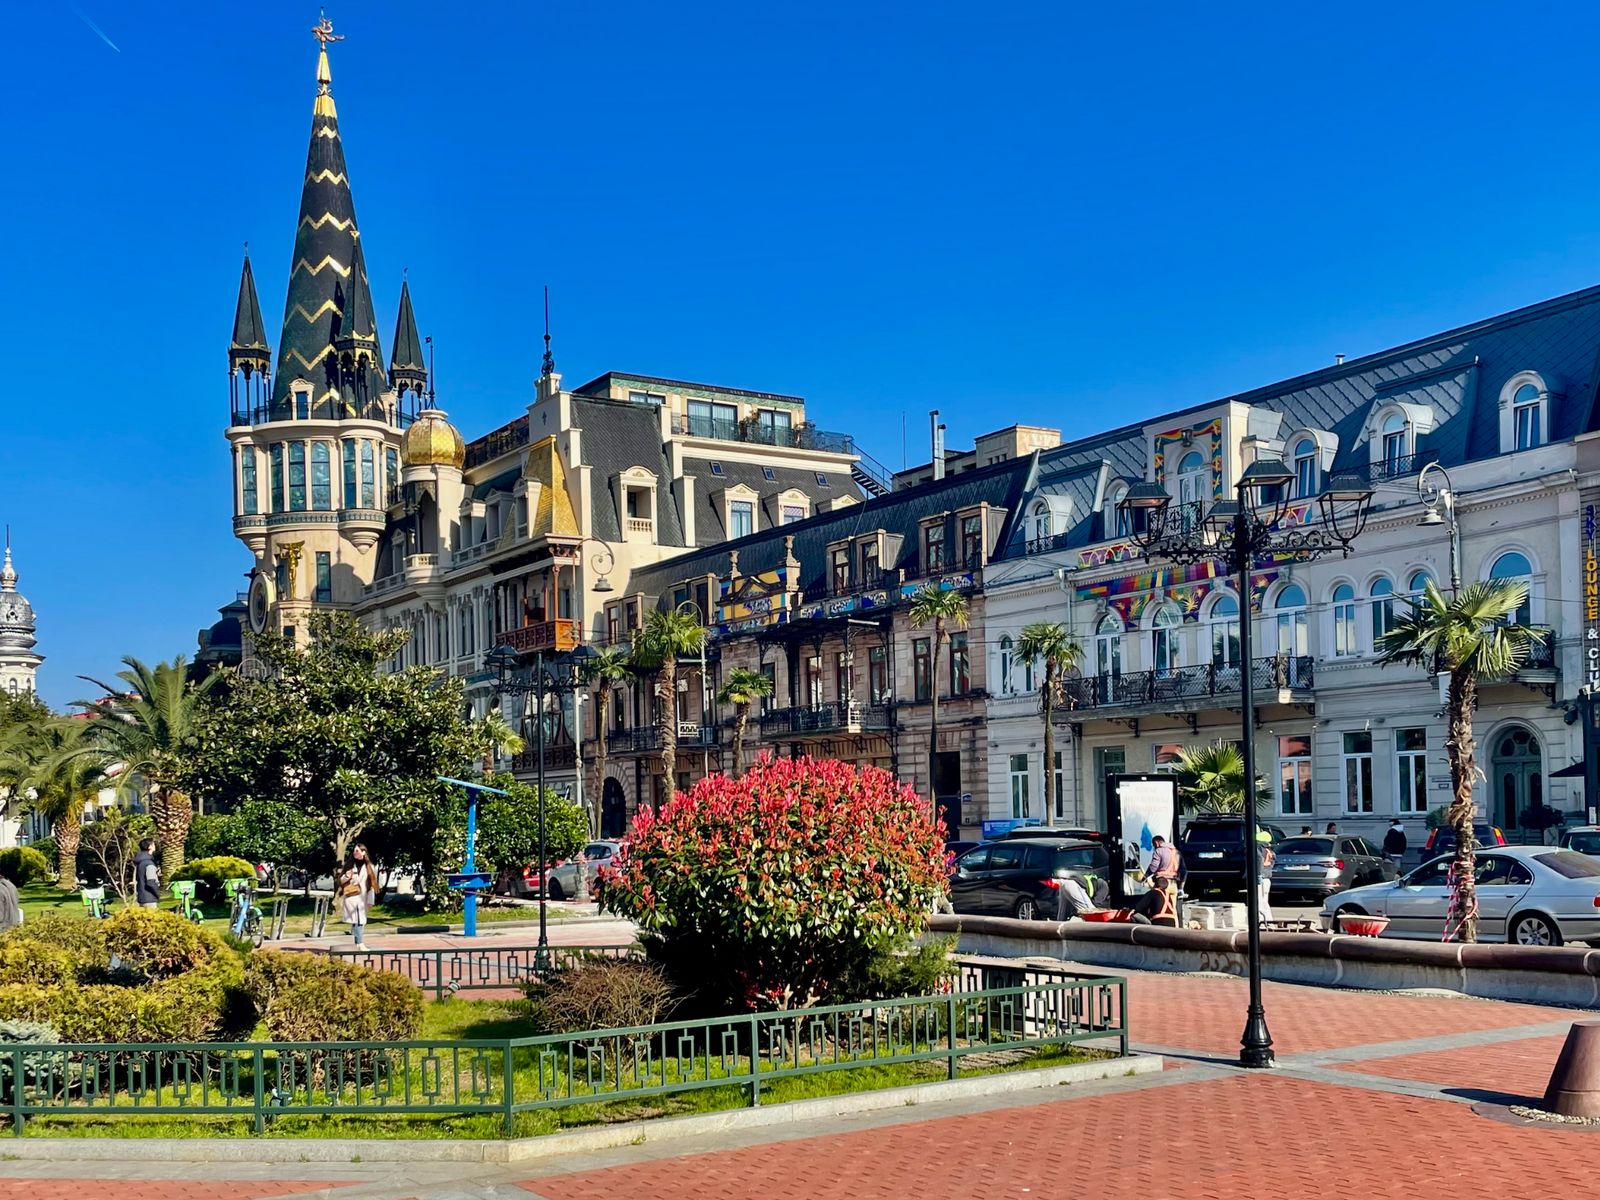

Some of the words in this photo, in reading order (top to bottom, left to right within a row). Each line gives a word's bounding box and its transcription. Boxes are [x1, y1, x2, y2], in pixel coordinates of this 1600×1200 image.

[1586, 504, 1597, 540] SKY
[1586, 549, 1598, 620] LOUNGE
[1587, 628, 1599, 640] &
[1588, 647, 1599, 683] CLU
